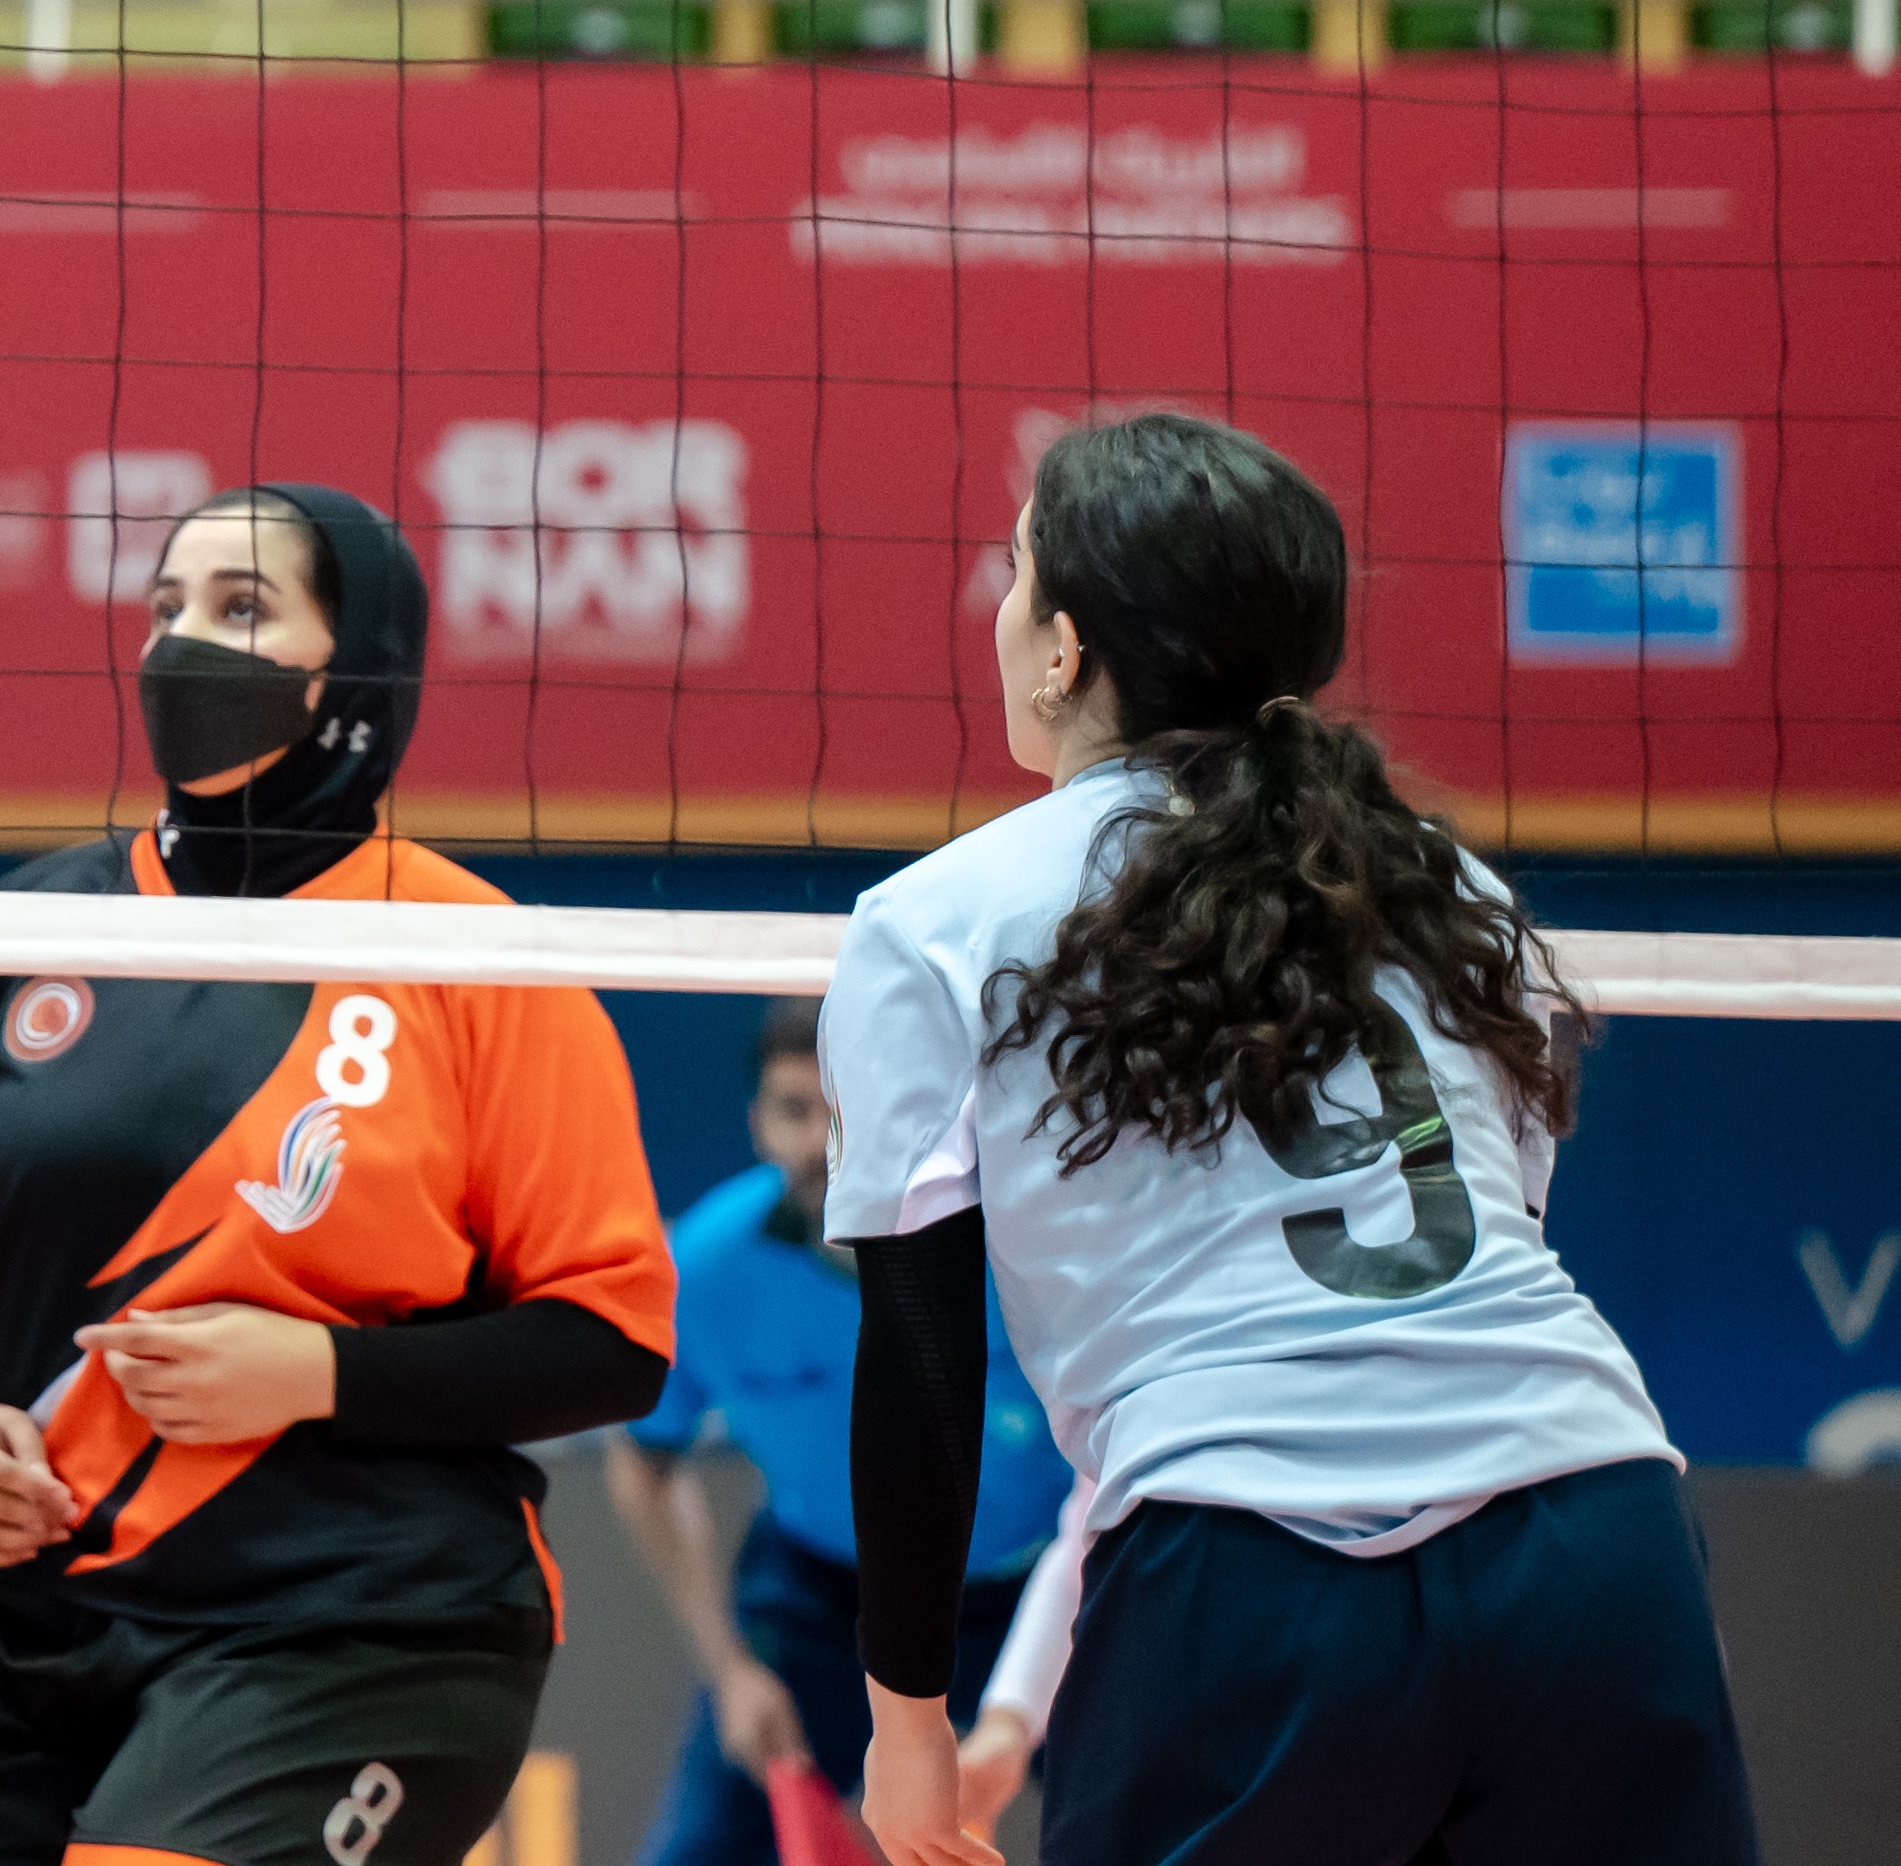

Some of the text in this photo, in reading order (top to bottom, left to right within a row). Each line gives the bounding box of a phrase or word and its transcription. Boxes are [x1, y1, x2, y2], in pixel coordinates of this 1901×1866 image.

[315, 994, 397, 1108] 8
[1236, 984, 1476, 1299] 9
[323, 1761, 404, 1866] 8
